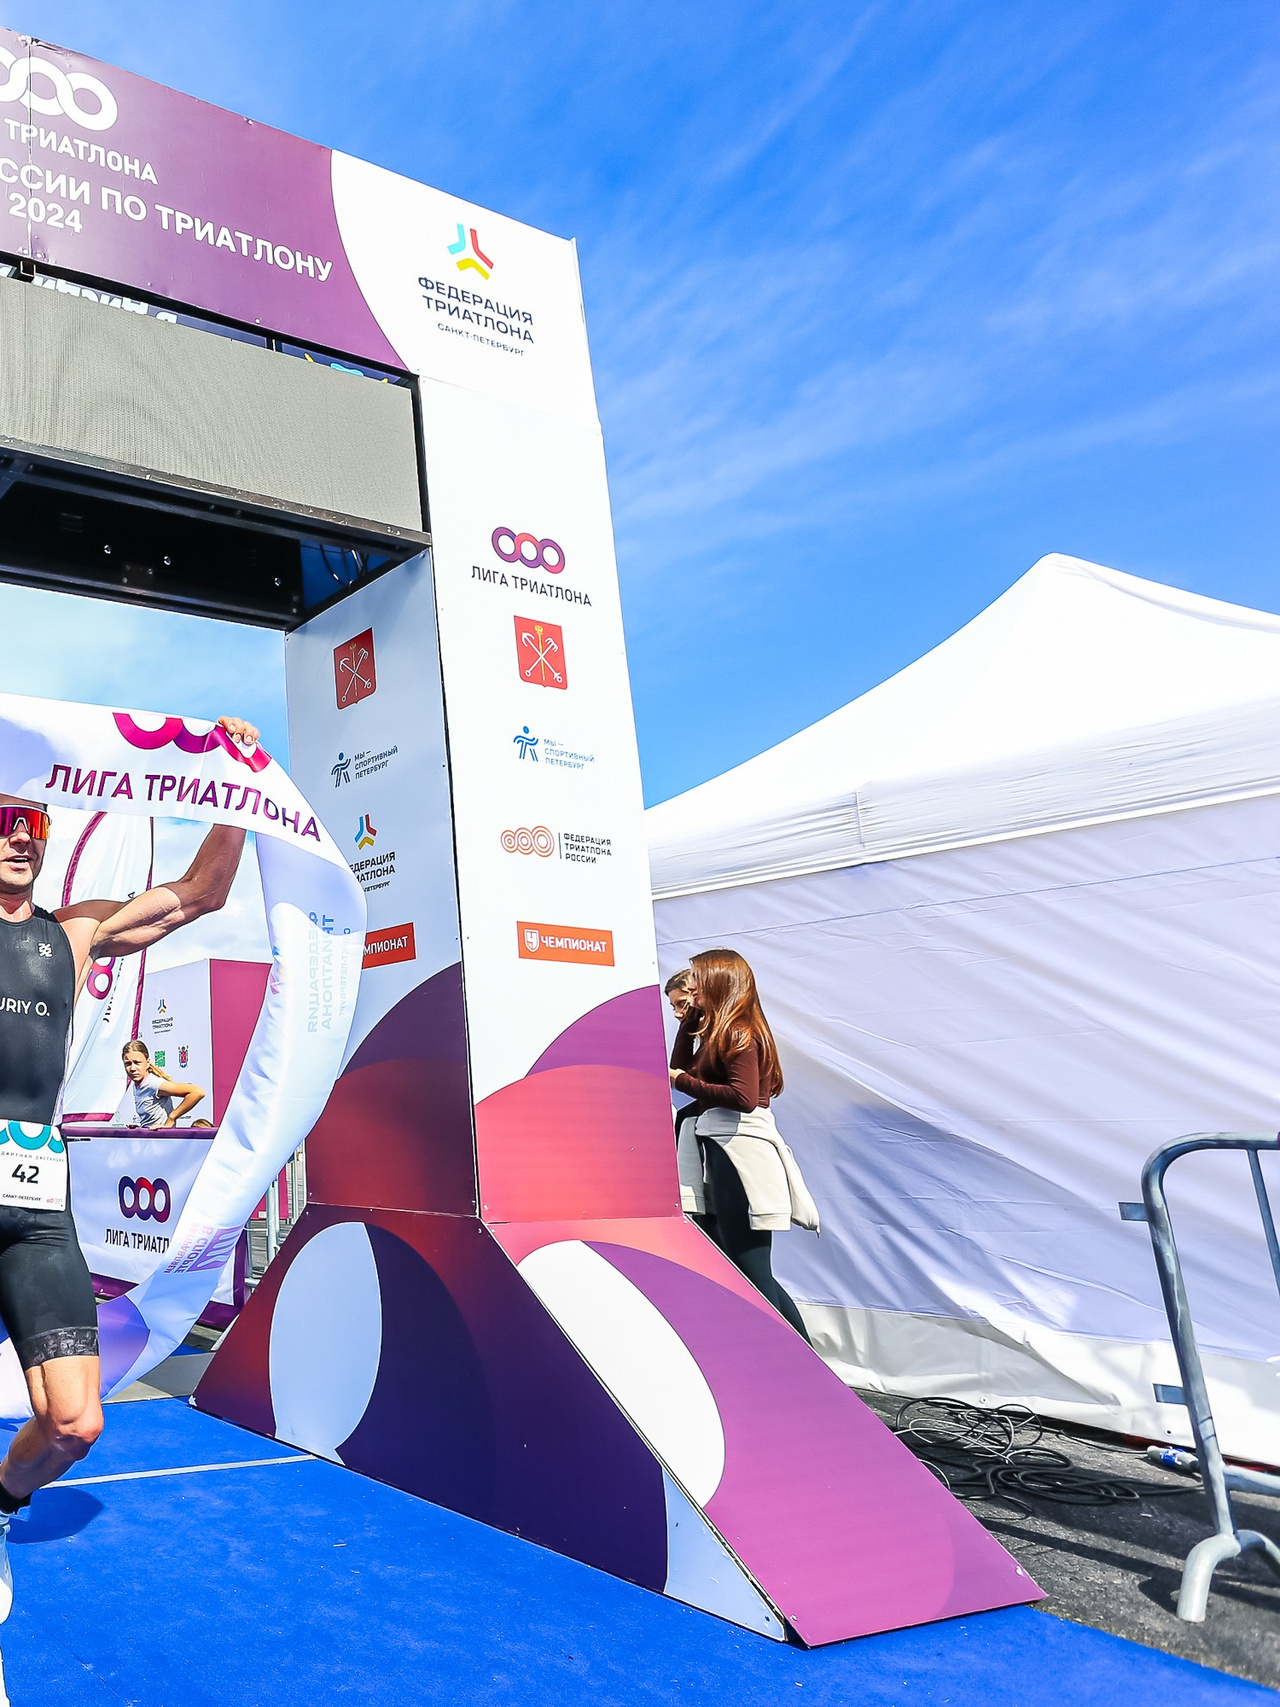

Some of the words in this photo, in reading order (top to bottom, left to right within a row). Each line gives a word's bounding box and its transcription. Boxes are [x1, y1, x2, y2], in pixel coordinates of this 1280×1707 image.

[3, 116, 159, 186] ТРИАТЛОНА
[8, 192, 83, 234] 2024
[101, 186, 148, 222] ПО
[154, 203, 333, 283] ТРИАТЛОНУ
[418, 276, 534, 326] ФЕДЕРАЦИЯ
[422, 295, 535, 344] ТРИАТЛОНА
[437, 322, 526, 357] САНКТ-ПЕТЕРБУРГ
[471, 565, 509, 587] ЛИГА
[511, 575, 592, 607] ТРИАТЛОНА
[544, 738, 556, 747] МЫ
[354, 751, 365, 761] МЫ
[354, 745, 398, 770] СПОРТИВНЫЙ
[544, 748, 595, 763] СПОРТИВНЫЙ
[545, 757, 585, 770] ПЕТЕРБУРГ
[355, 760, 389, 779] ПЕТЕРБУРГ
[45, 764, 133, 800] ЛИГА
[144, 774, 321, 842] ТРИАТЛОНА
[563, 832, 611, 847] ФЕДЕРАЦИЯ
[564, 842, 612, 856] ТРИАТЛОНА
[349, 851, 396, 874] ЕДЕРАЦИЯ
[565, 853, 596, 864] РОССИИ
[356, 864, 396, 883] ИАТЛОНА
[364, 935, 408, 957] МПИОНАТ
[540, 935, 607, 953] ЧЕМПИОНАТ
[35, 1001, 51, 1017] O.
[11, 1164, 40, 1184] 42
[105, 1228, 130, 1248] ЛИГА
[131, 1232, 170, 1254] ТРИАТЛ
